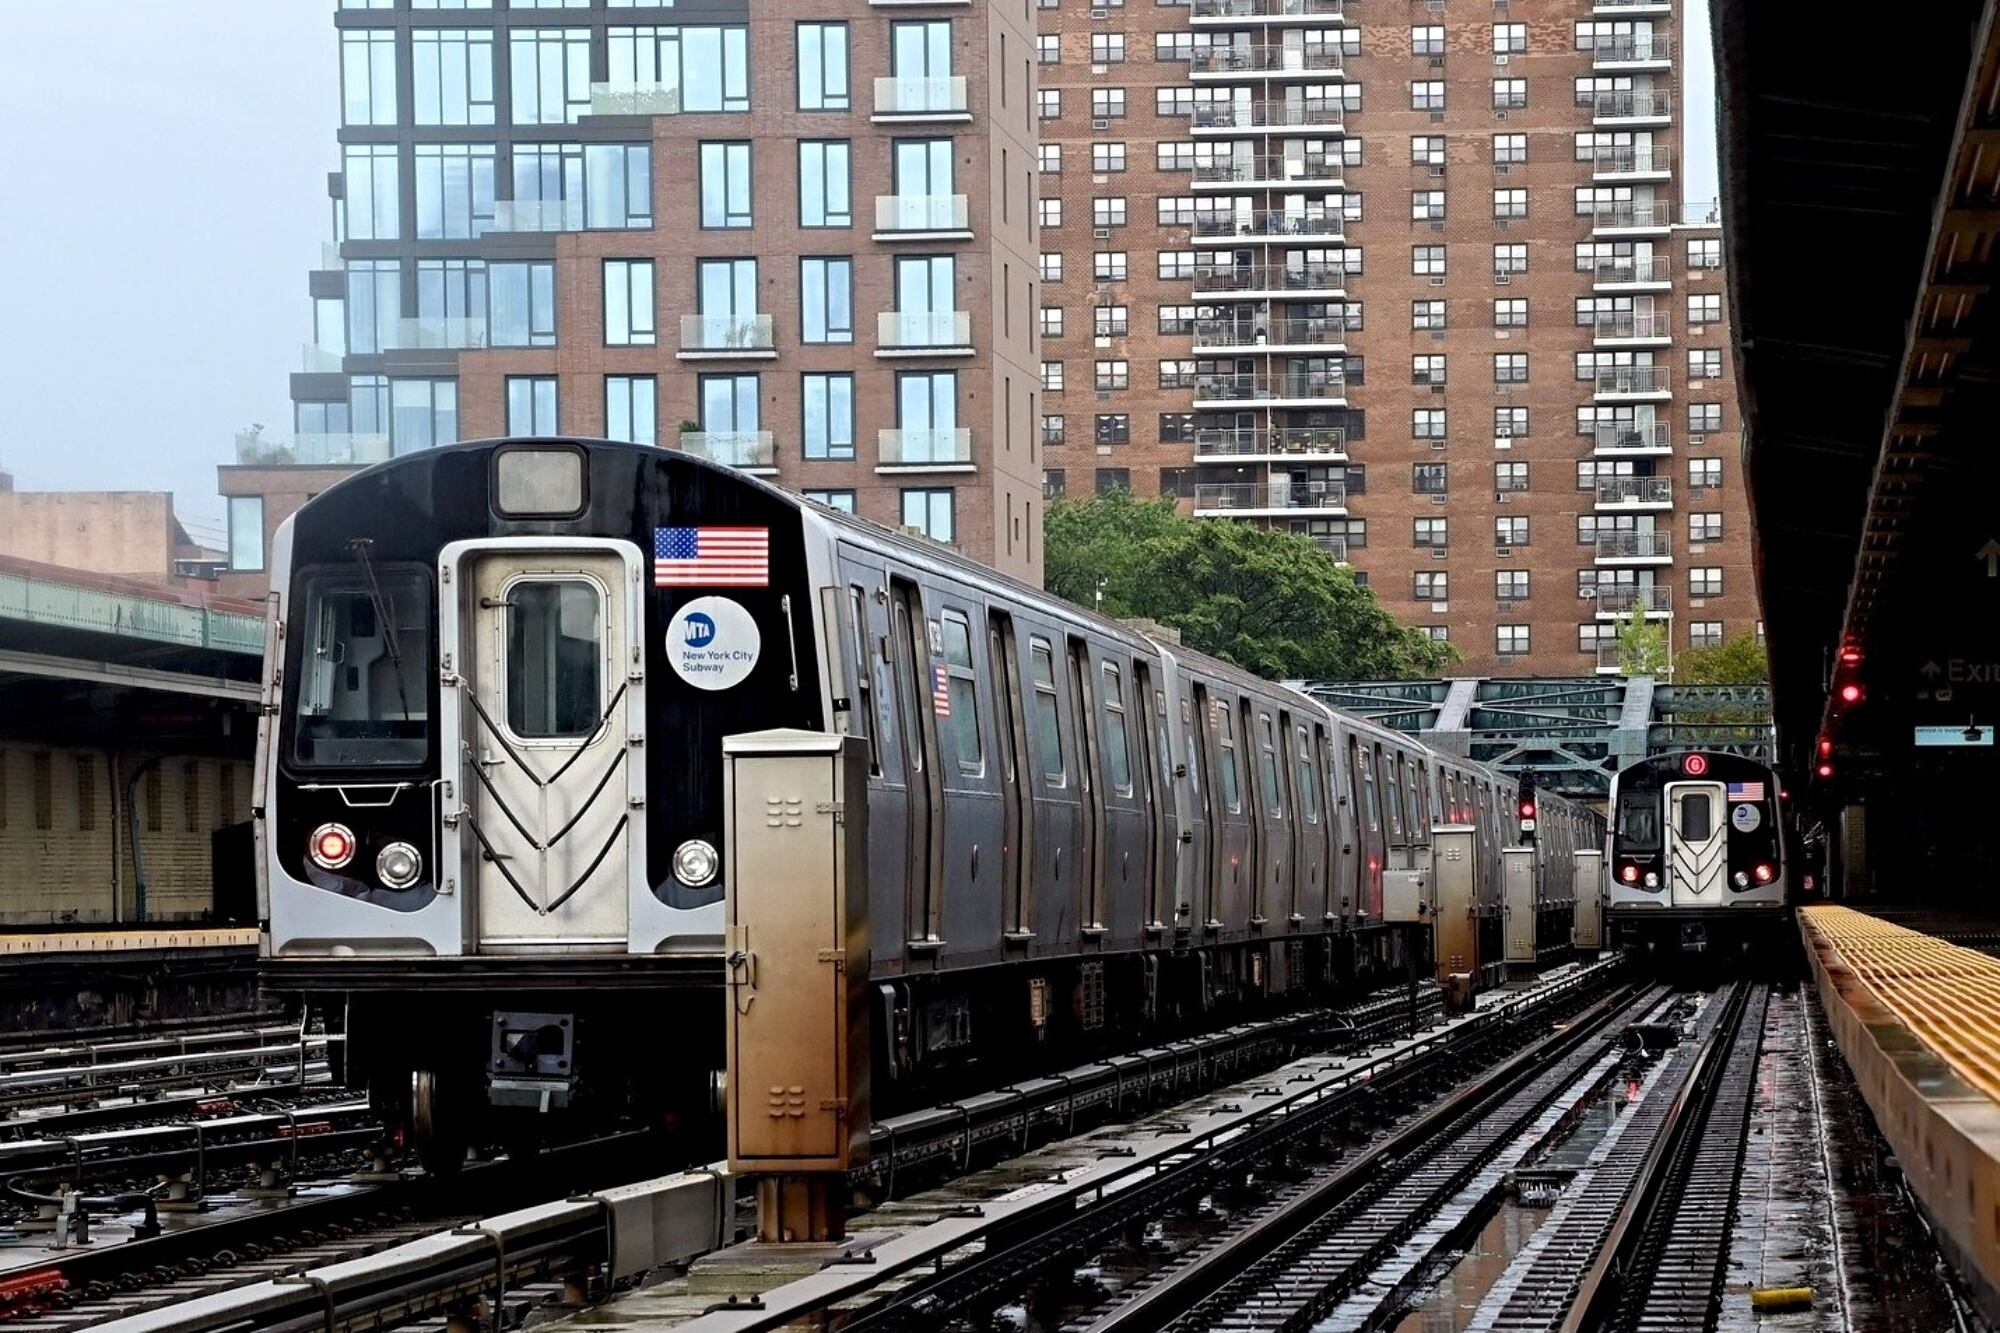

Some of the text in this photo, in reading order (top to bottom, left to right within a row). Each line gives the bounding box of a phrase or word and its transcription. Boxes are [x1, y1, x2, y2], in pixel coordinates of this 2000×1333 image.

[684, 620, 710, 640] MTA
[683, 651, 753, 662] New York City
[683, 662, 724, 673] Subway
